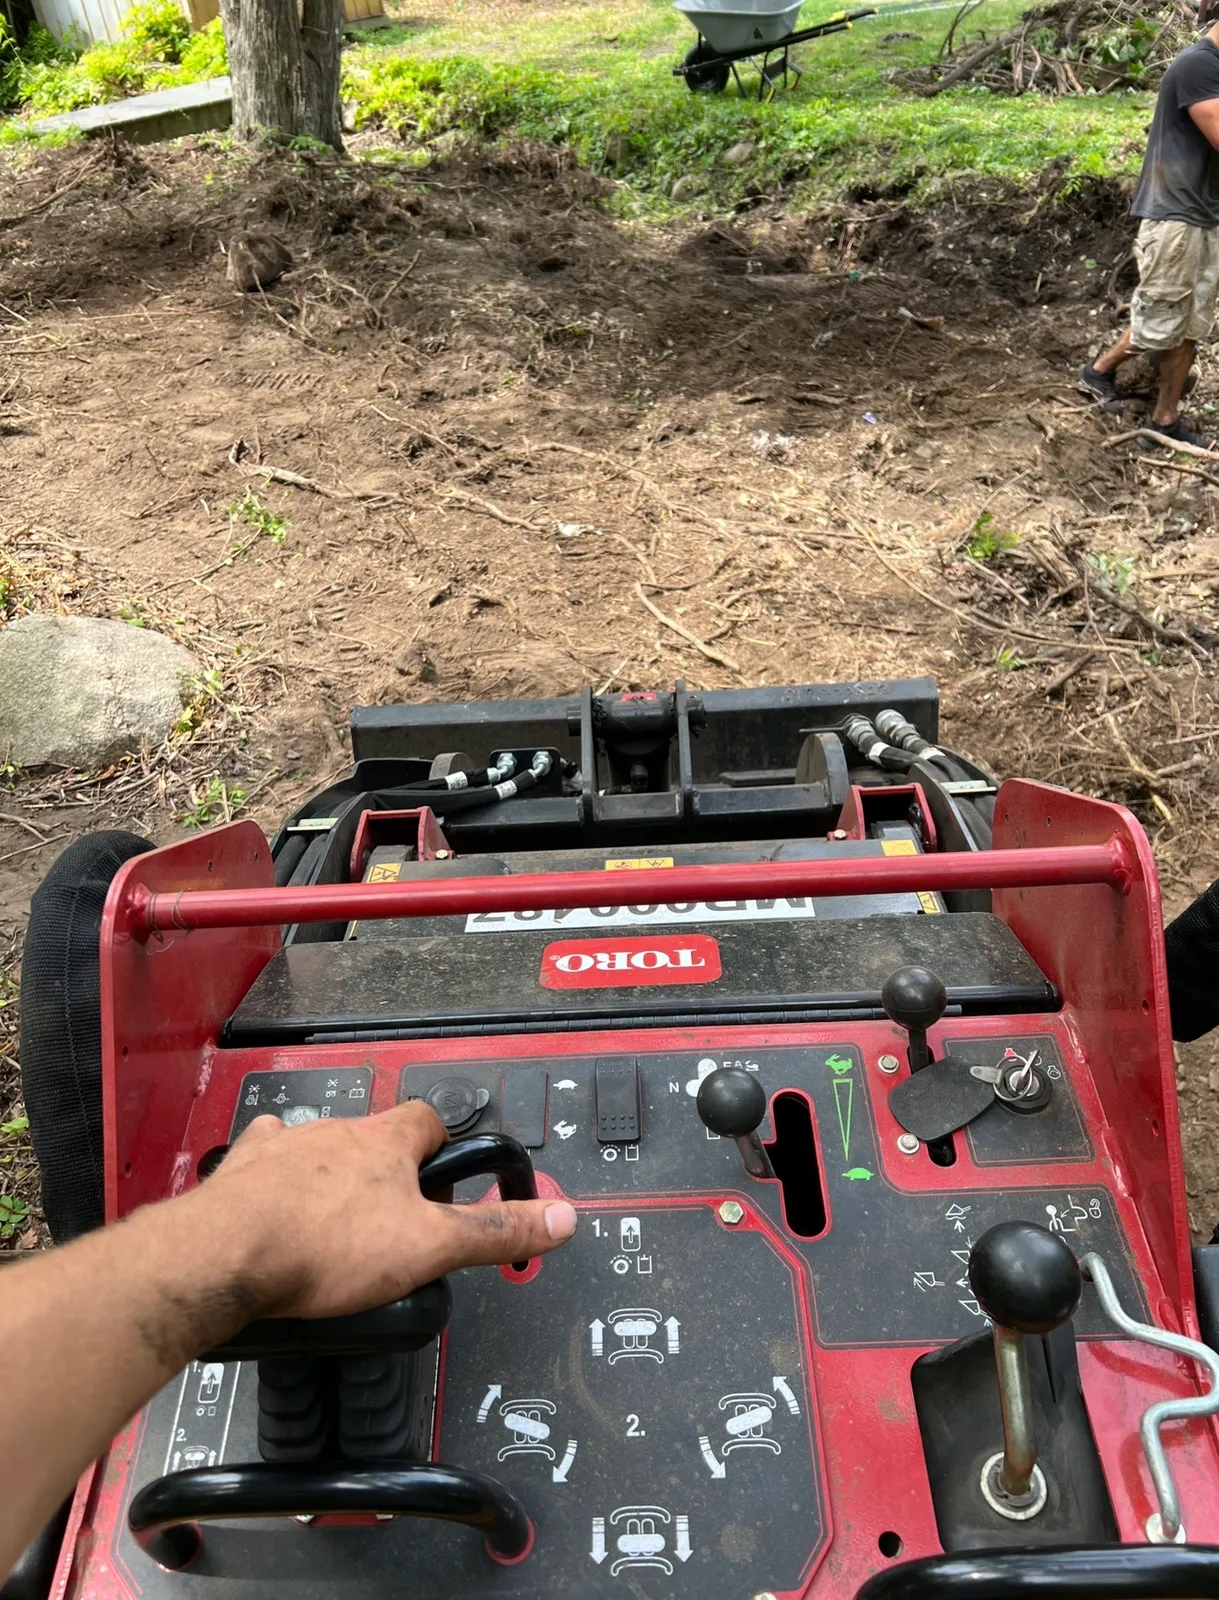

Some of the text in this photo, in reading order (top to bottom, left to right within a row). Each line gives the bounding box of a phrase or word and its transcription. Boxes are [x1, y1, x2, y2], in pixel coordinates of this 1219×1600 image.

[669, 1081, 680, 1093] N
[591, 1218, 609, 1238] 1.
[626, 1413, 646, 1437] 2.
[175, 1427, 188, 1442] 2.
